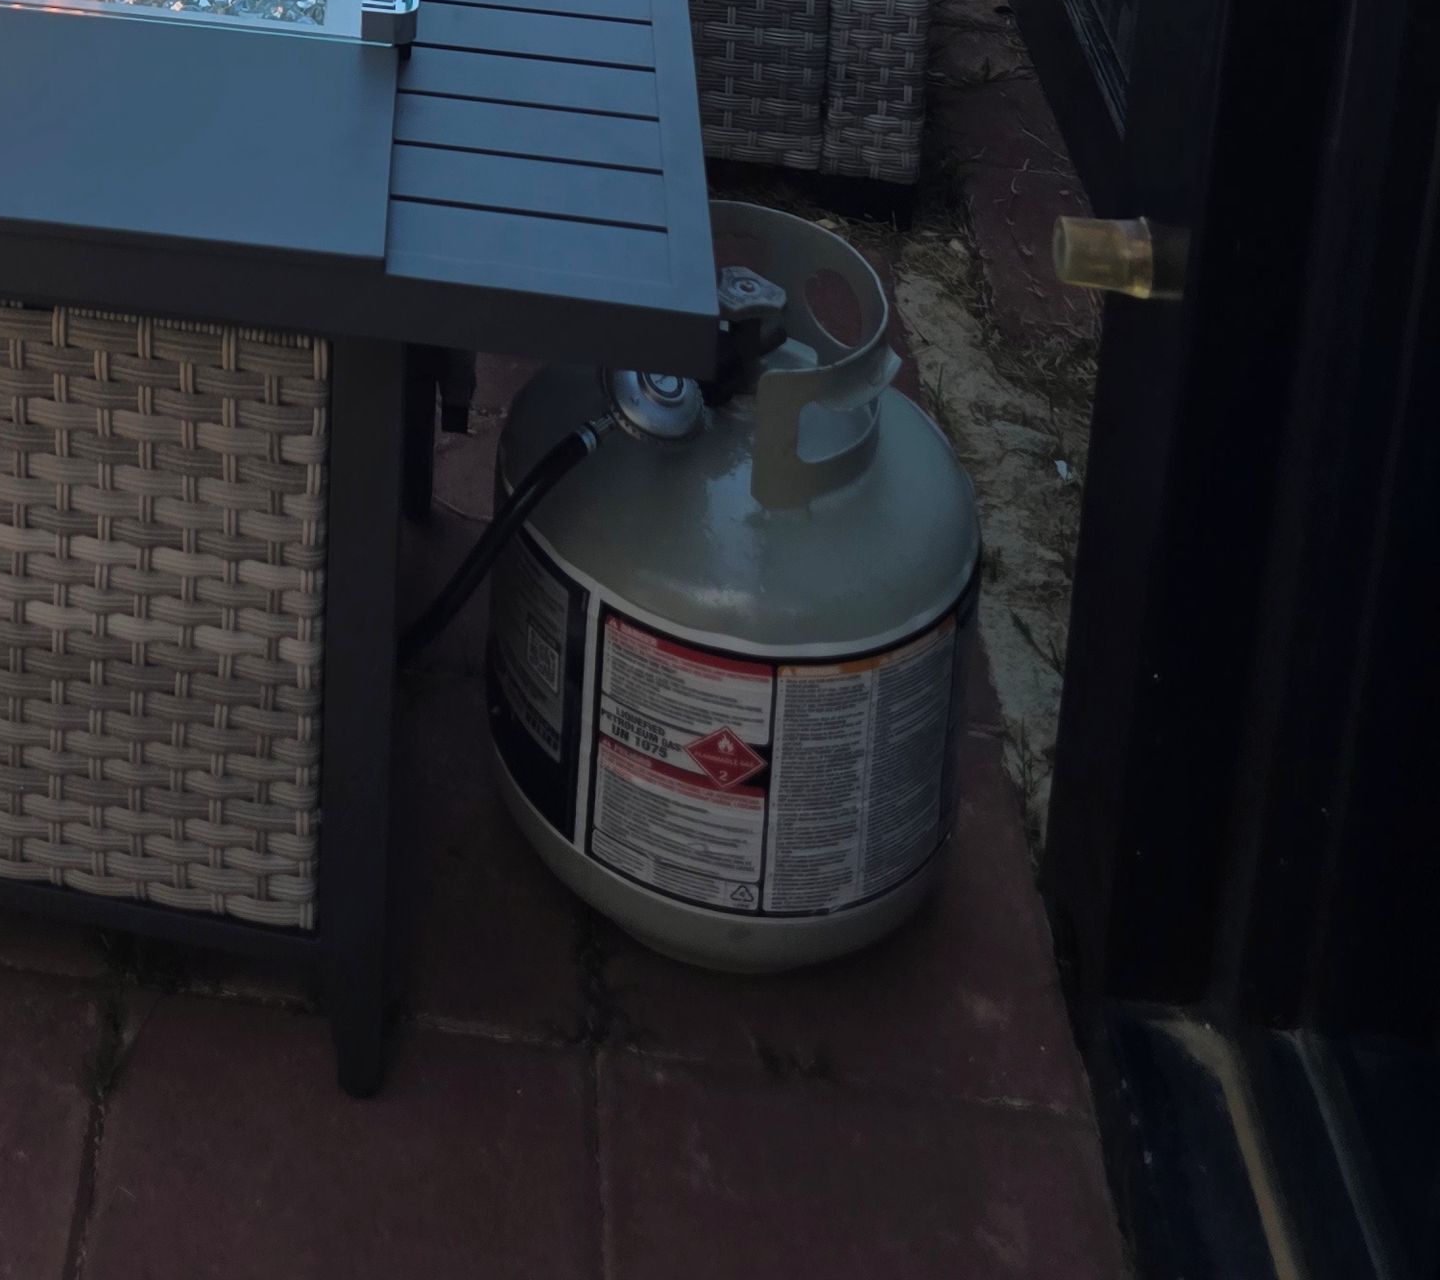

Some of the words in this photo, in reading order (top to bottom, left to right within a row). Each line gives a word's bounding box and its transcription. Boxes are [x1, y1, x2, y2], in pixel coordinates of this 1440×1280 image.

[601, 708, 659, 743] PETROLEUM
[615, 706, 665, 736] LIQUEFIED
[612, 723, 630, 741] UN
[635, 735, 668, 759] 1075
[719, 770, 729, 781] 2
